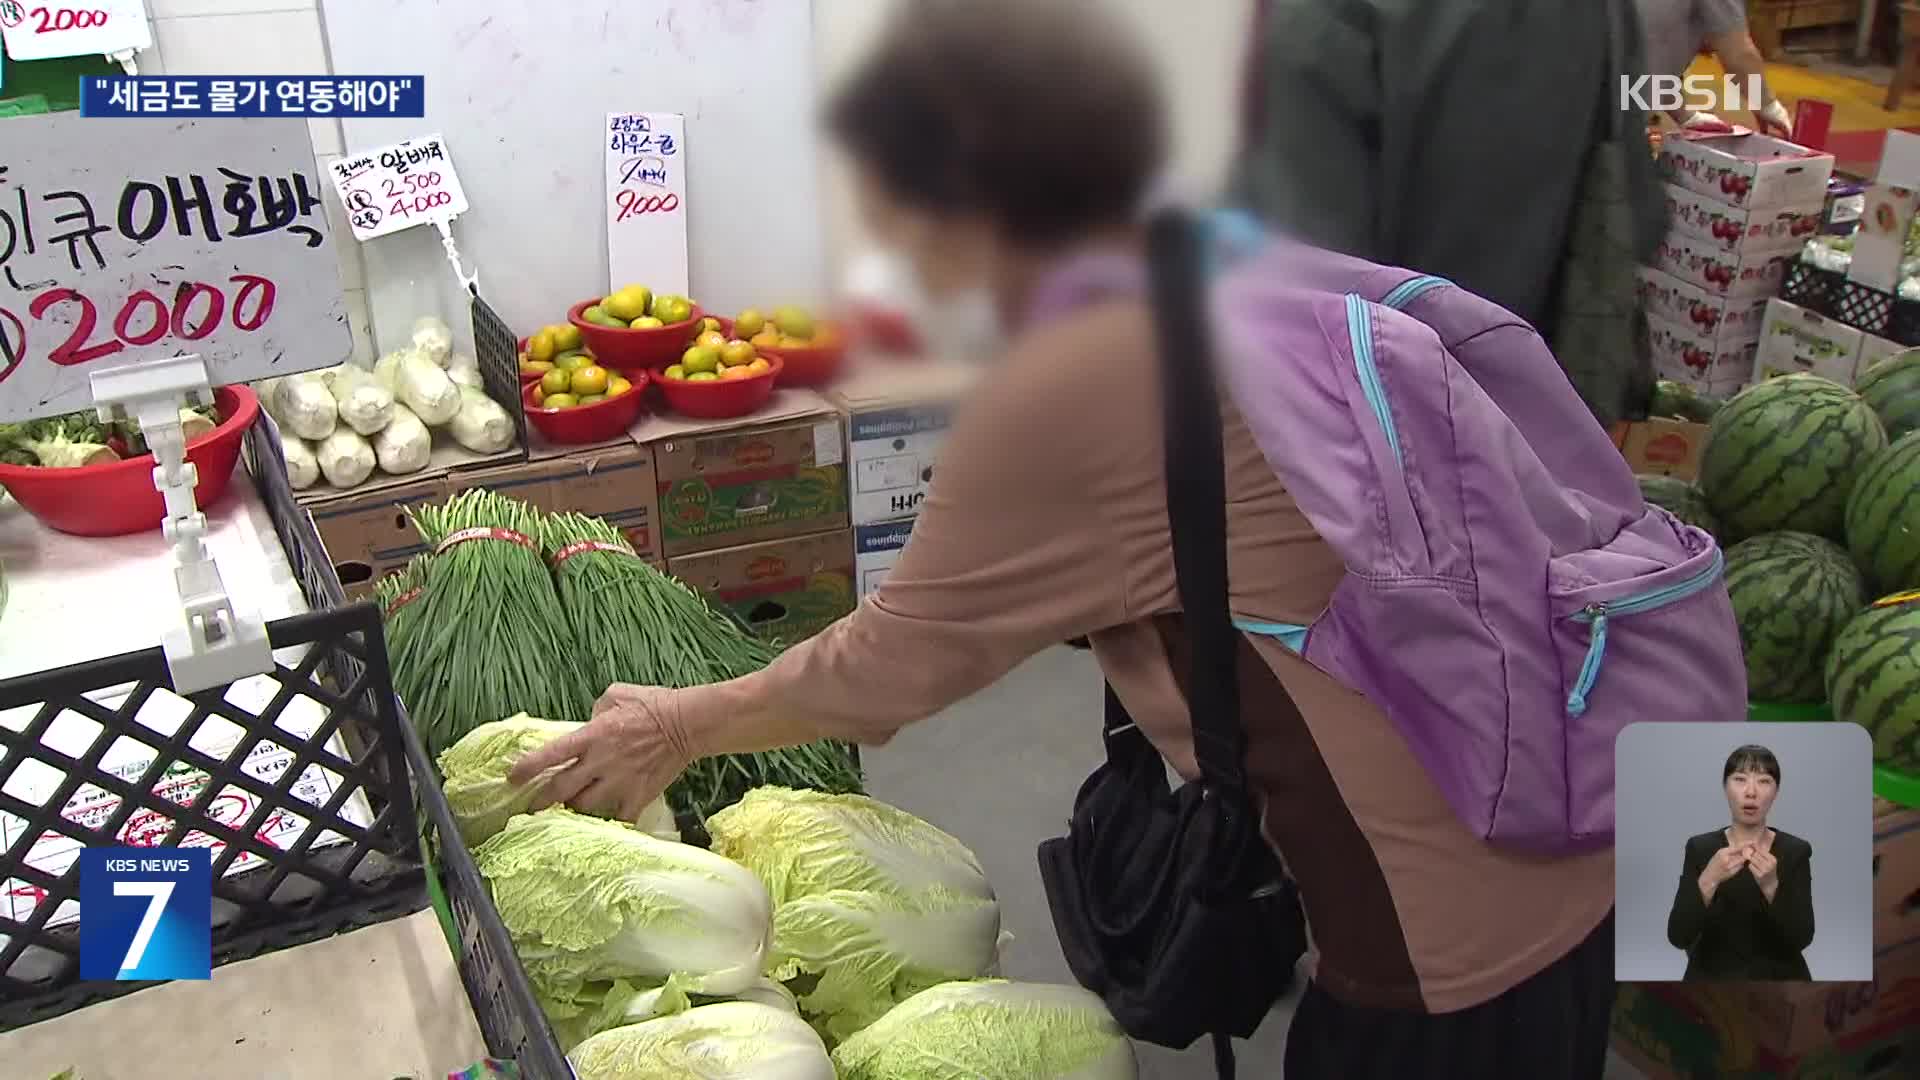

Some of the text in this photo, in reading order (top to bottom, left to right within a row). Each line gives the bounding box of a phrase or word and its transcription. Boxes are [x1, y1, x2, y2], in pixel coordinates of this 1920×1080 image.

[30, 7, 107, 33] 2000
[381, 171, 441, 198] 2500
[117, 167, 323, 248] 애호박
[389, 191, 451, 219] 4000
[29, 275, 276, 366] 2000
